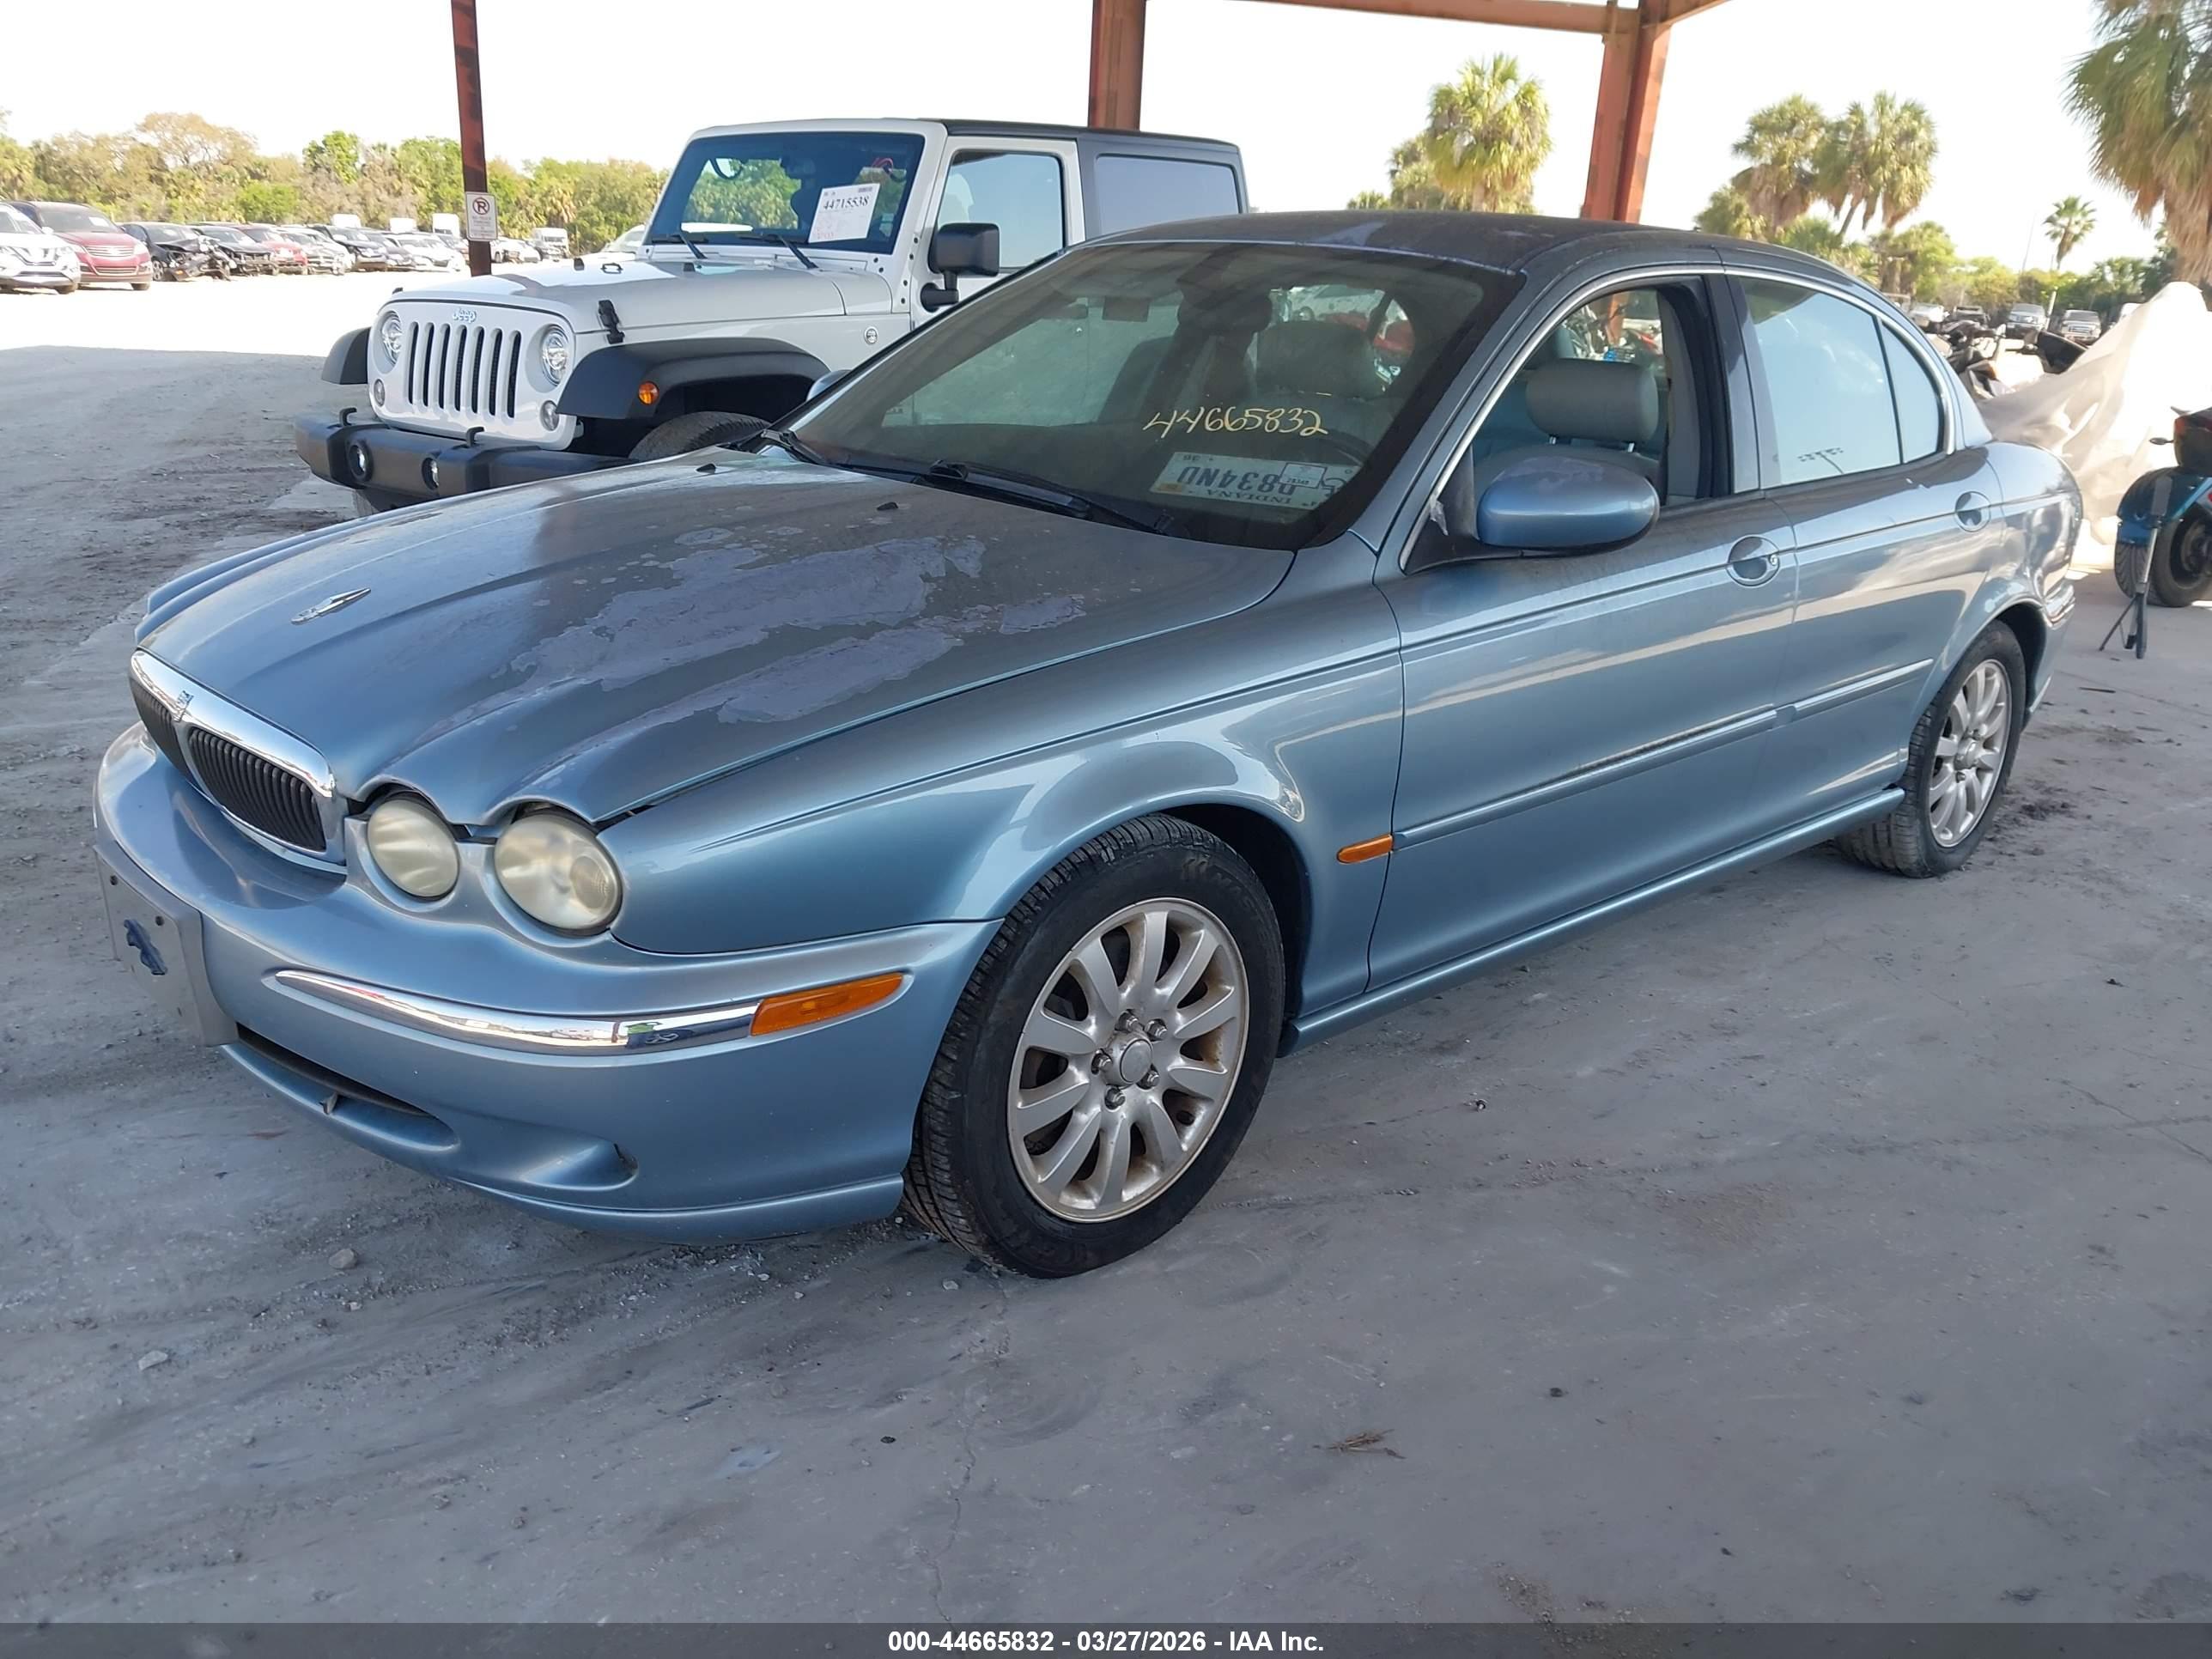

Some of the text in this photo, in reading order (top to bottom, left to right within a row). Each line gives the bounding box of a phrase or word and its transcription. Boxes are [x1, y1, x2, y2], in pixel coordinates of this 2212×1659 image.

[823, 195, 869, 210] 44715538
[453, 307, 477, 324] Jeep
[1143, 406, 1328, 439] 44665832
[1207, 489, 1291, 506] INDIANA
